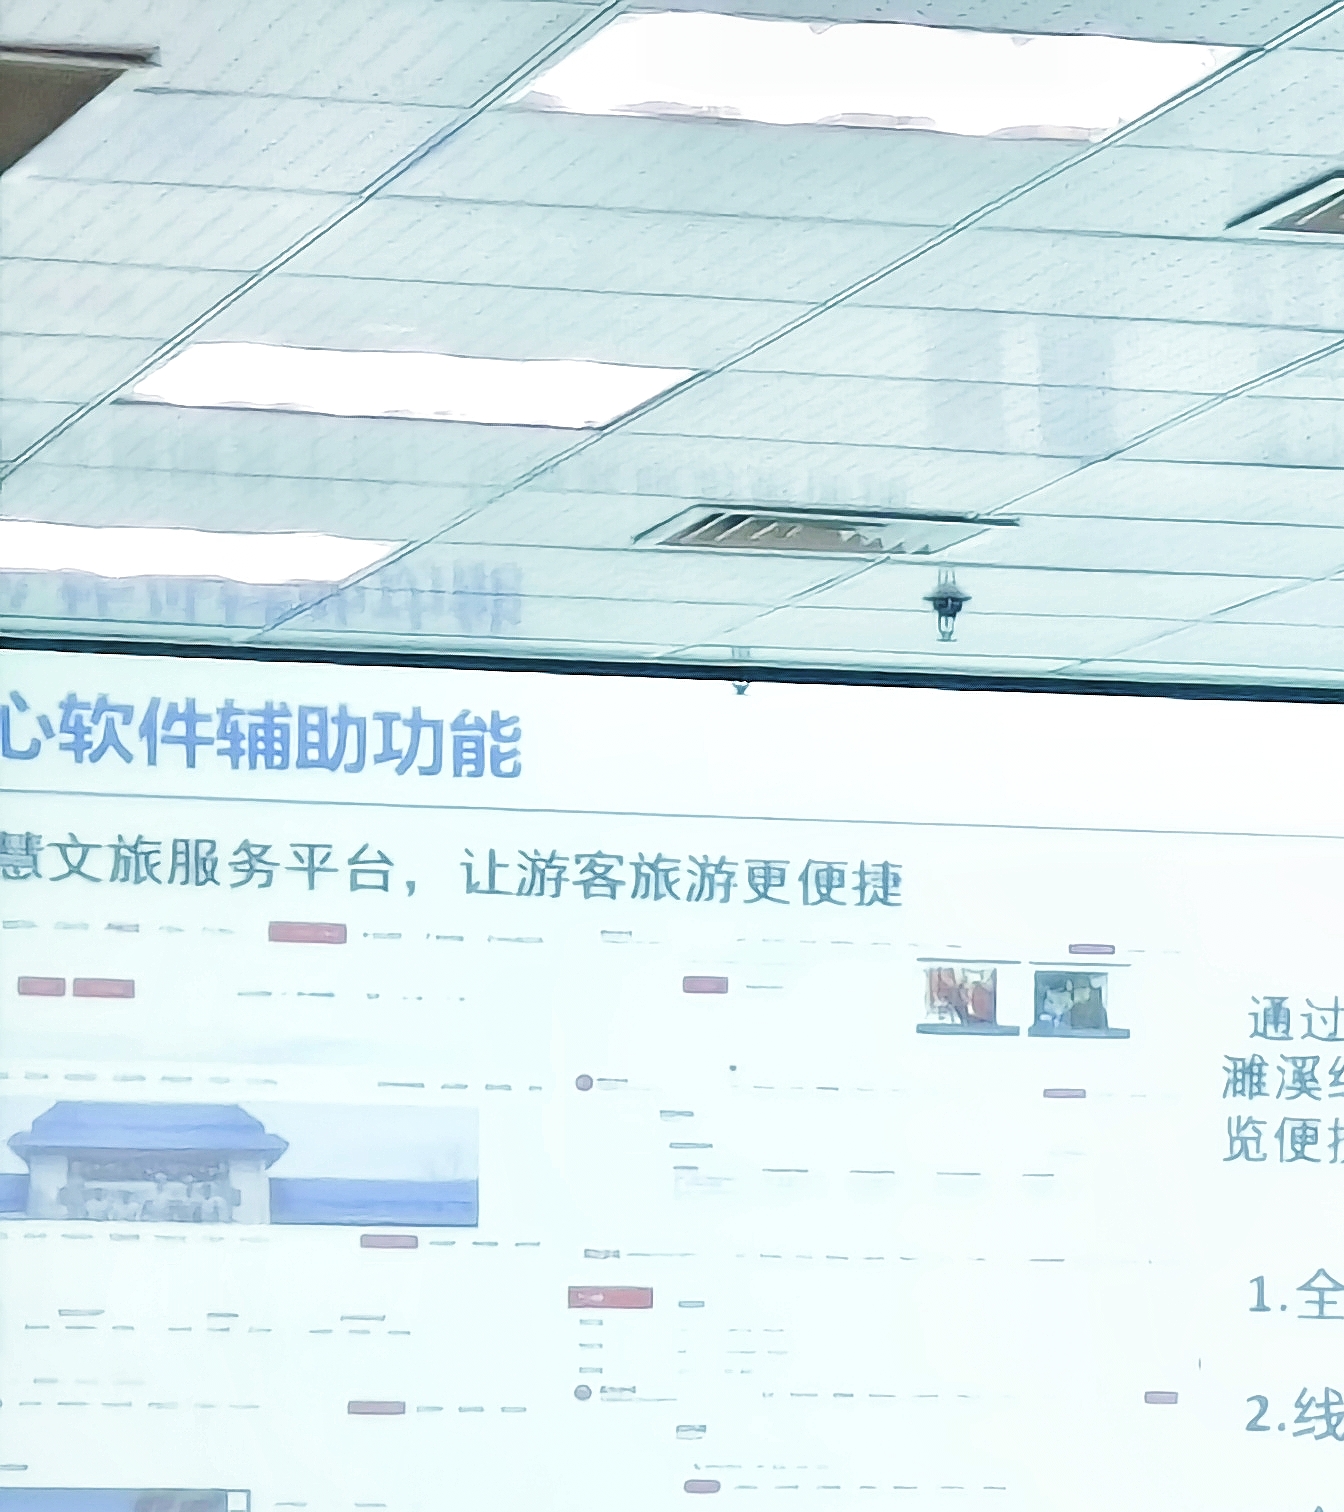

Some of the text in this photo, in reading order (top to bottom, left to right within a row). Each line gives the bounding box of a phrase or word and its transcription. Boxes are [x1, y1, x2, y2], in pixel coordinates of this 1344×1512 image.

[0, 690, 522, 779] 心软件辅助功能
